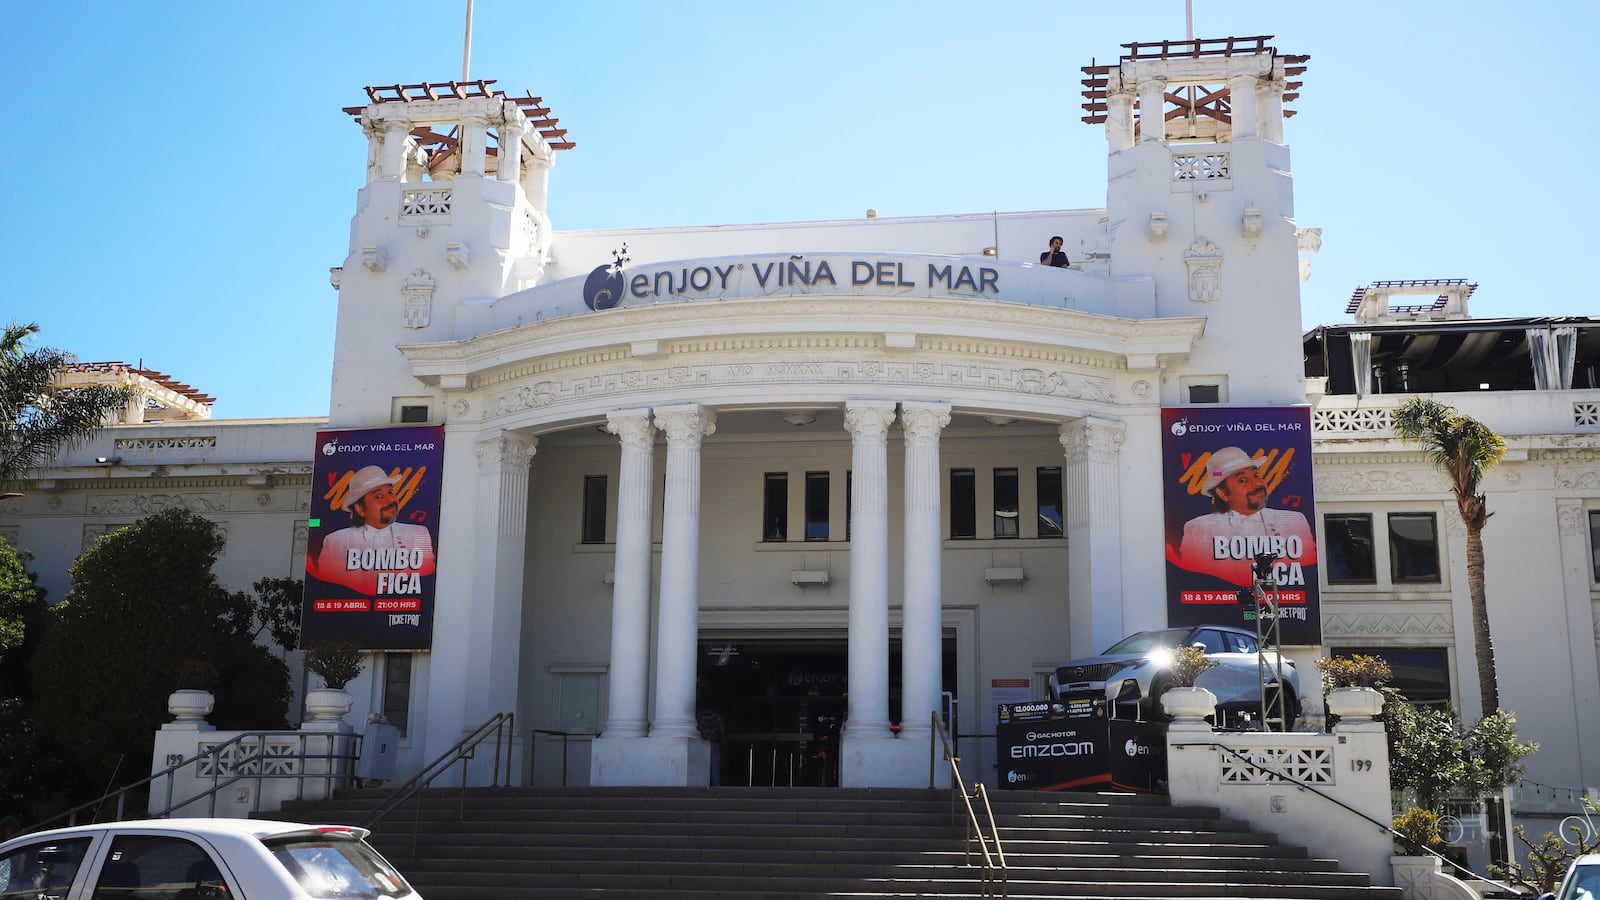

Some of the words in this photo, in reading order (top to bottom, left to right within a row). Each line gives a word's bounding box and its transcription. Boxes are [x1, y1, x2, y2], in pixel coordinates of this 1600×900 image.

[752, 255, 837, 288] VIÑA
[851, 261, 915, 287] DEL
[928, 264, 1000, 293] MAR
[1226, 422, 1252, 432] VIÑA
[1255, 423, 1275, 432] DEL
[1278, 422, 1302, 432] MAR
[370, 442, 392, 452] VIÑA
[395, 443, 412, 451] DEL
[414, 443, 435, 451] MAR
[1213, 535, 1303, 560] BOMBO
[347, 547, 424, 571] BOMBO
[377, 572, 421, 595] FICA
[1216, 593, 1237, 601] ABRI
[1282, 593, 1300, 601] HRS
[377, 601, 398, 609] 21:00
[400, 601, 416, 609] HRS
[388, 614, 421, 627] TICKETPRO
[1011, 741, 1094, 759] EMZOOM
[166, 754, 183, 766] 199
[1351, 759, 1372, 772] 199
